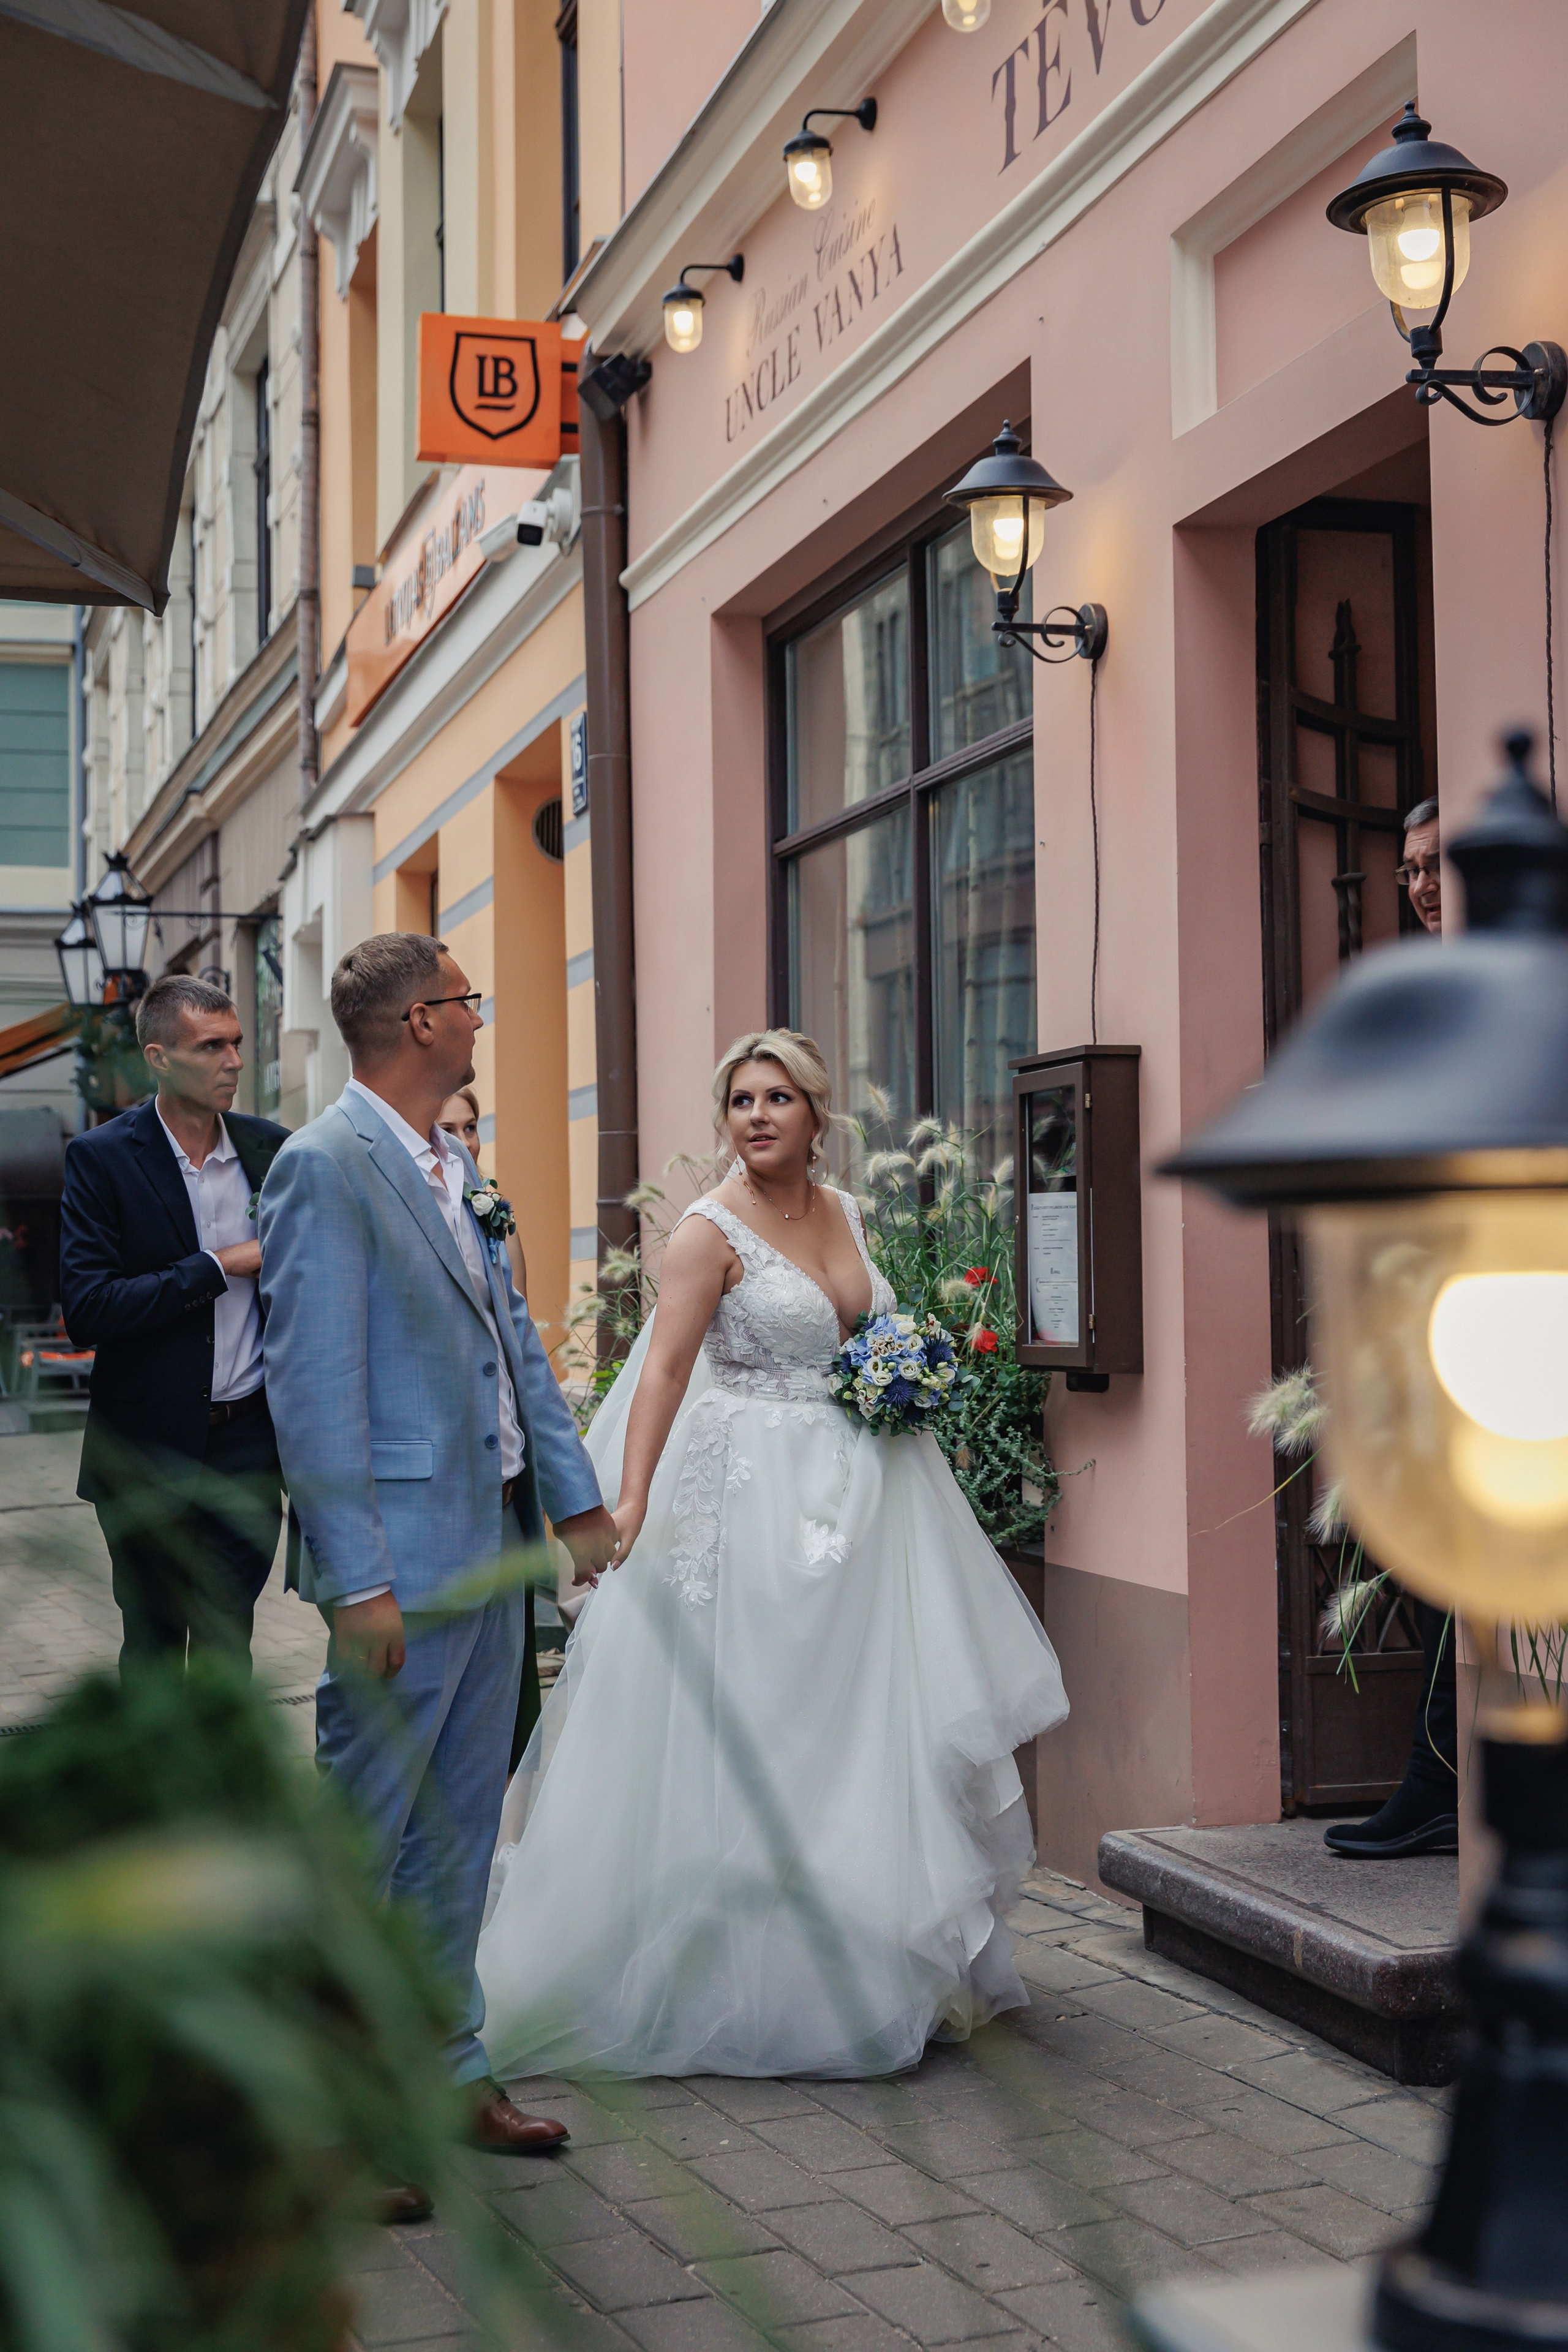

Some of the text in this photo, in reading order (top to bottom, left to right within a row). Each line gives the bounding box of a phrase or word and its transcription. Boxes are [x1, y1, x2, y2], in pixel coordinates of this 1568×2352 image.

[725, 223, 904, 443] UNCLE VANYA
[745, 198, 876, 358] Russian Cuisine
[477, 354, 518, 398] LB
